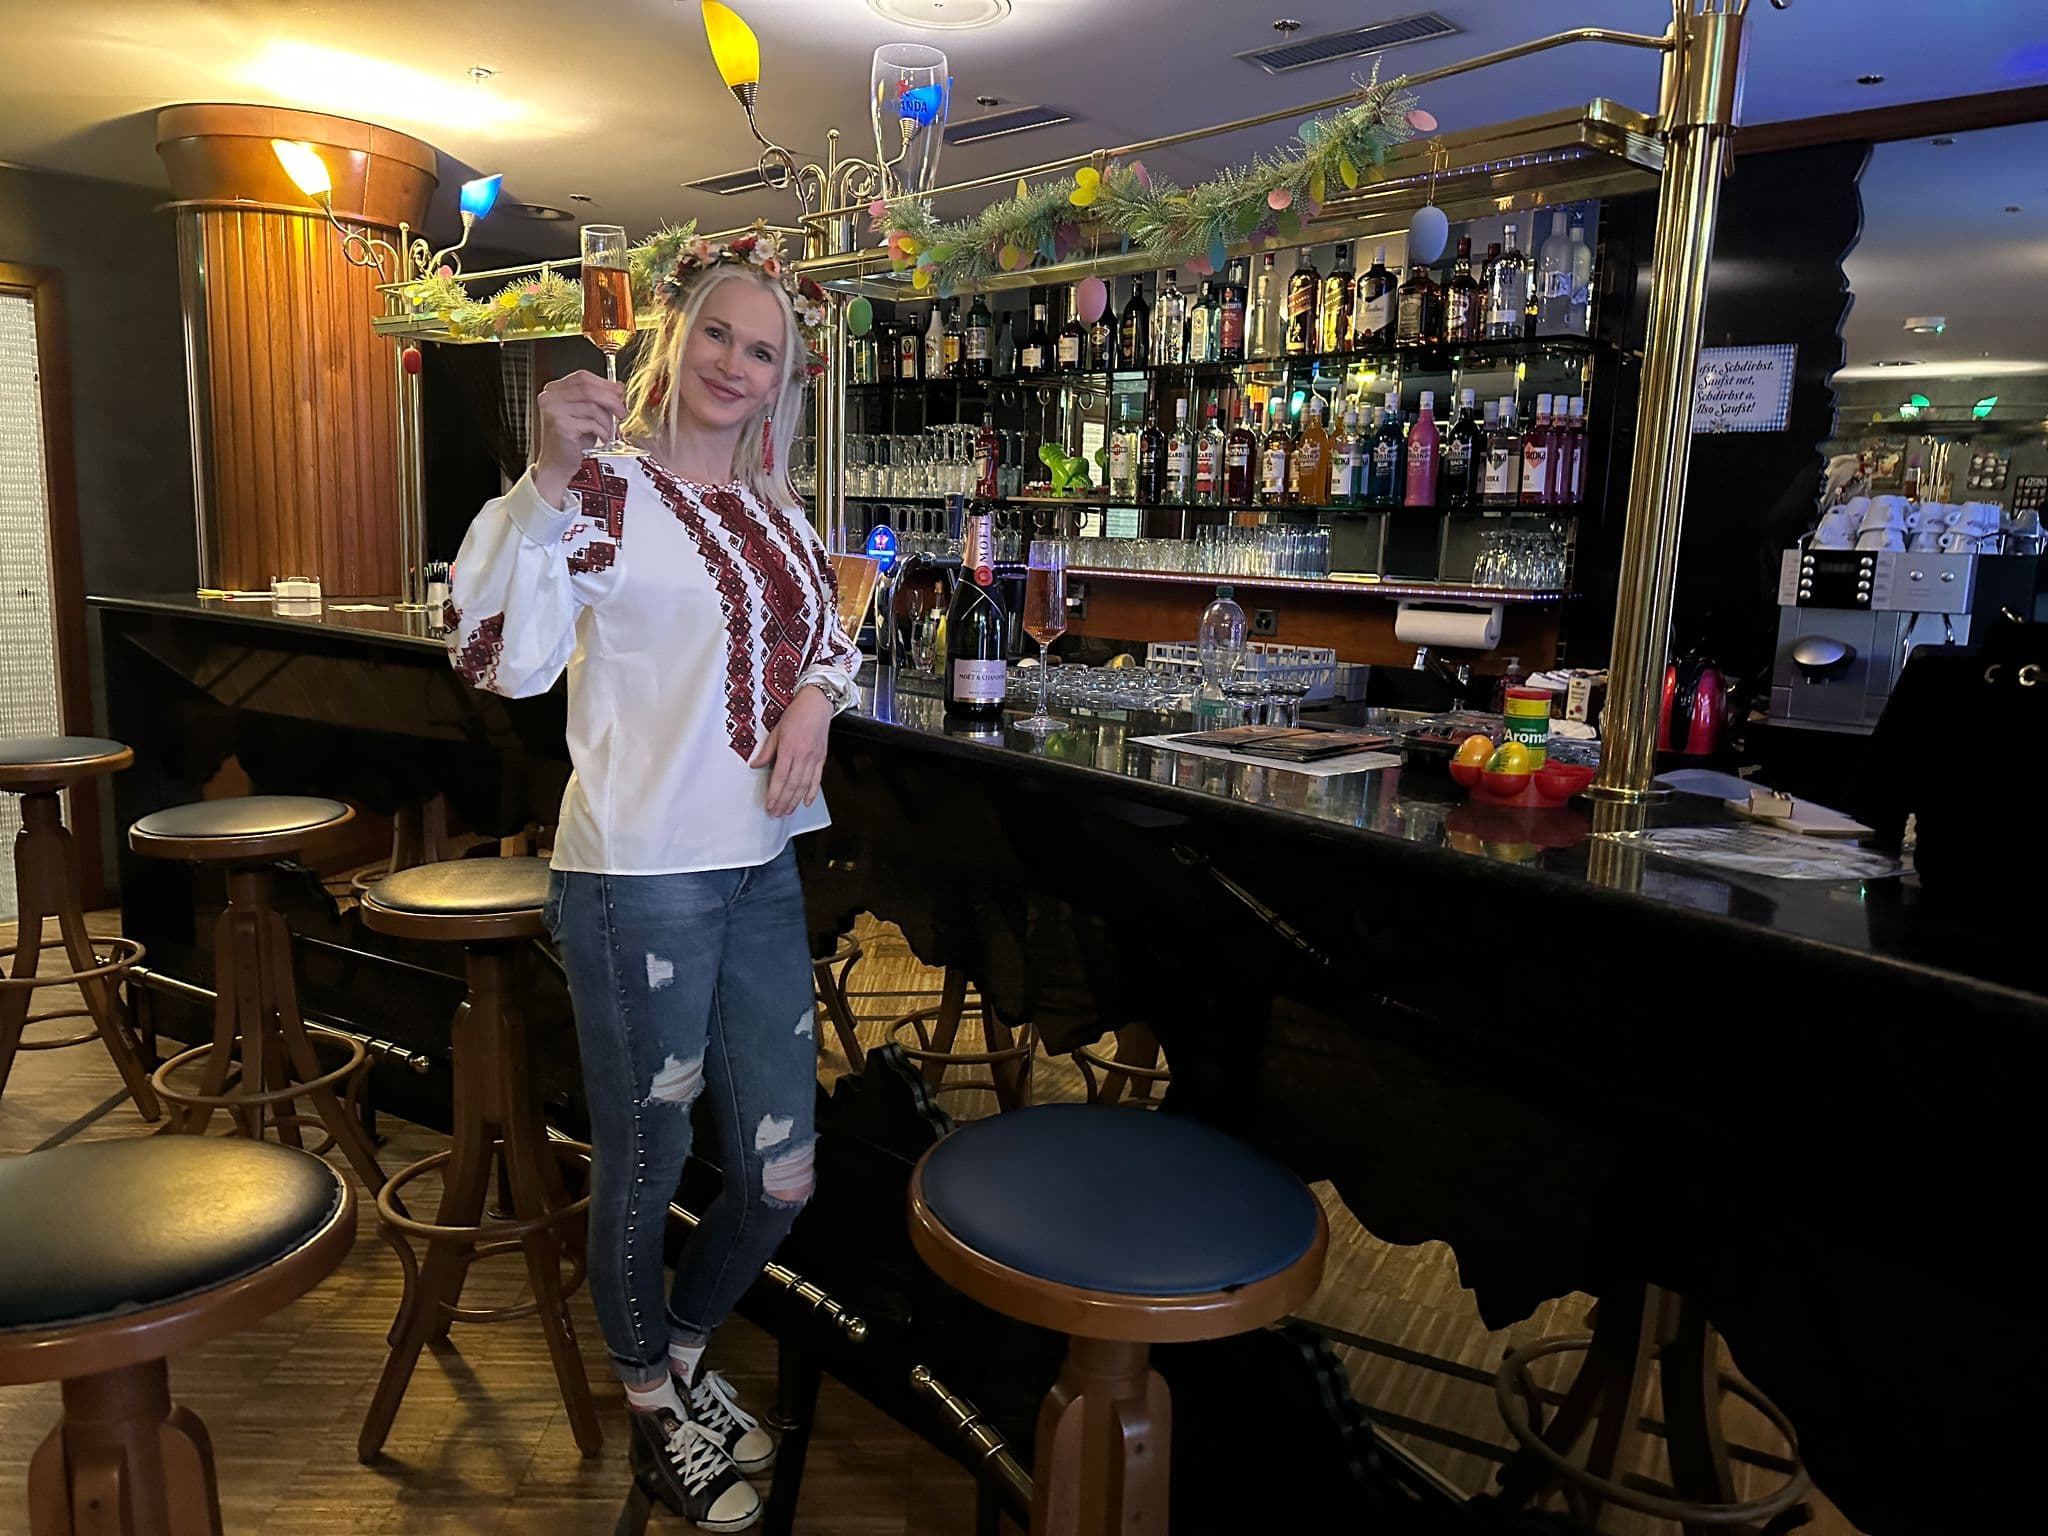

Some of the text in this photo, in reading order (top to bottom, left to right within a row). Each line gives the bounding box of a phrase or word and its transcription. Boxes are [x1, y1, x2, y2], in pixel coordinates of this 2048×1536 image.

[1735, 376, 1754, 386] net,
[1745, 392, 1755, 400] a.
[1714, 401, 1756, 417] Saufst!
